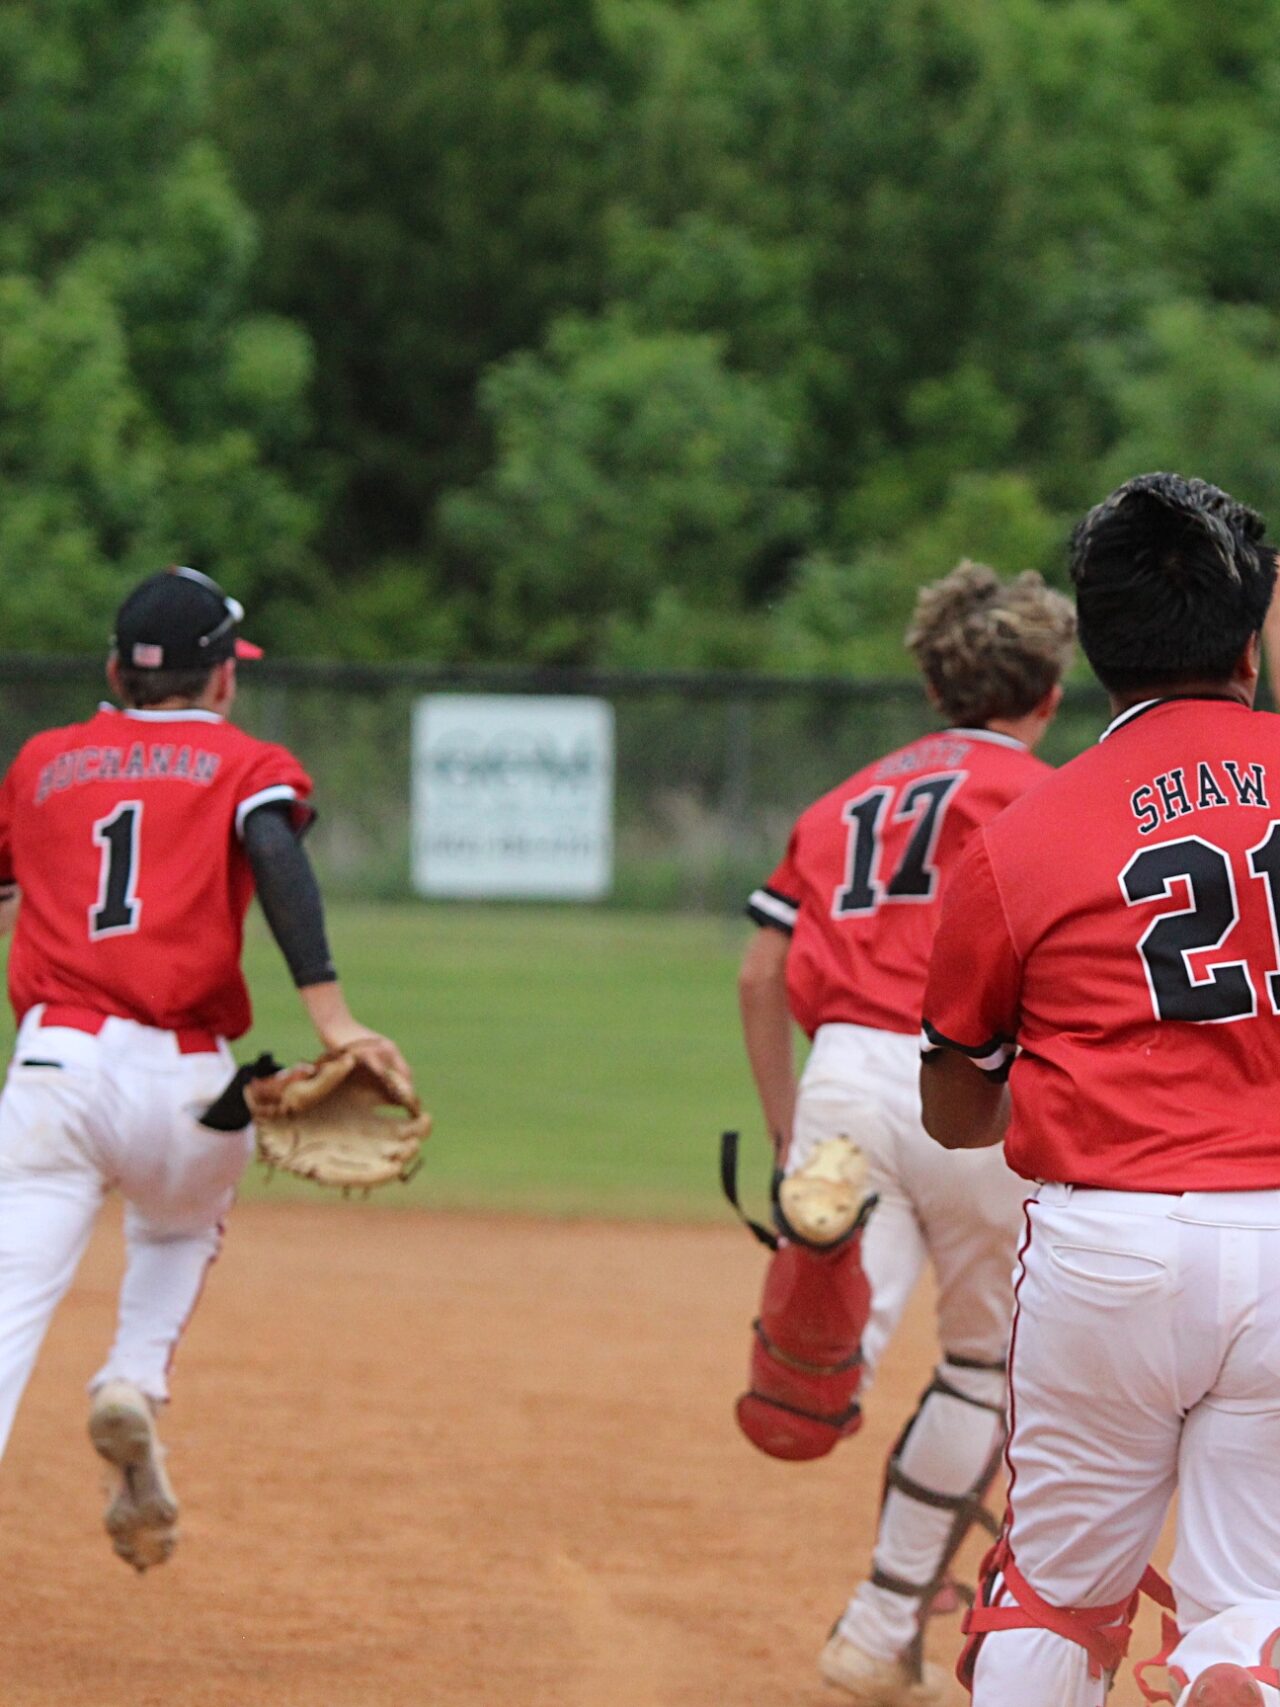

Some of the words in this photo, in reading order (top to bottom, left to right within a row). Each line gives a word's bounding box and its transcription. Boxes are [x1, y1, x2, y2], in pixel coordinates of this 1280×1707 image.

[831, 769, 970, 920] 17
[1129, 760, 1270, 835] SHAW
[88, 800, 143, 941] 1
